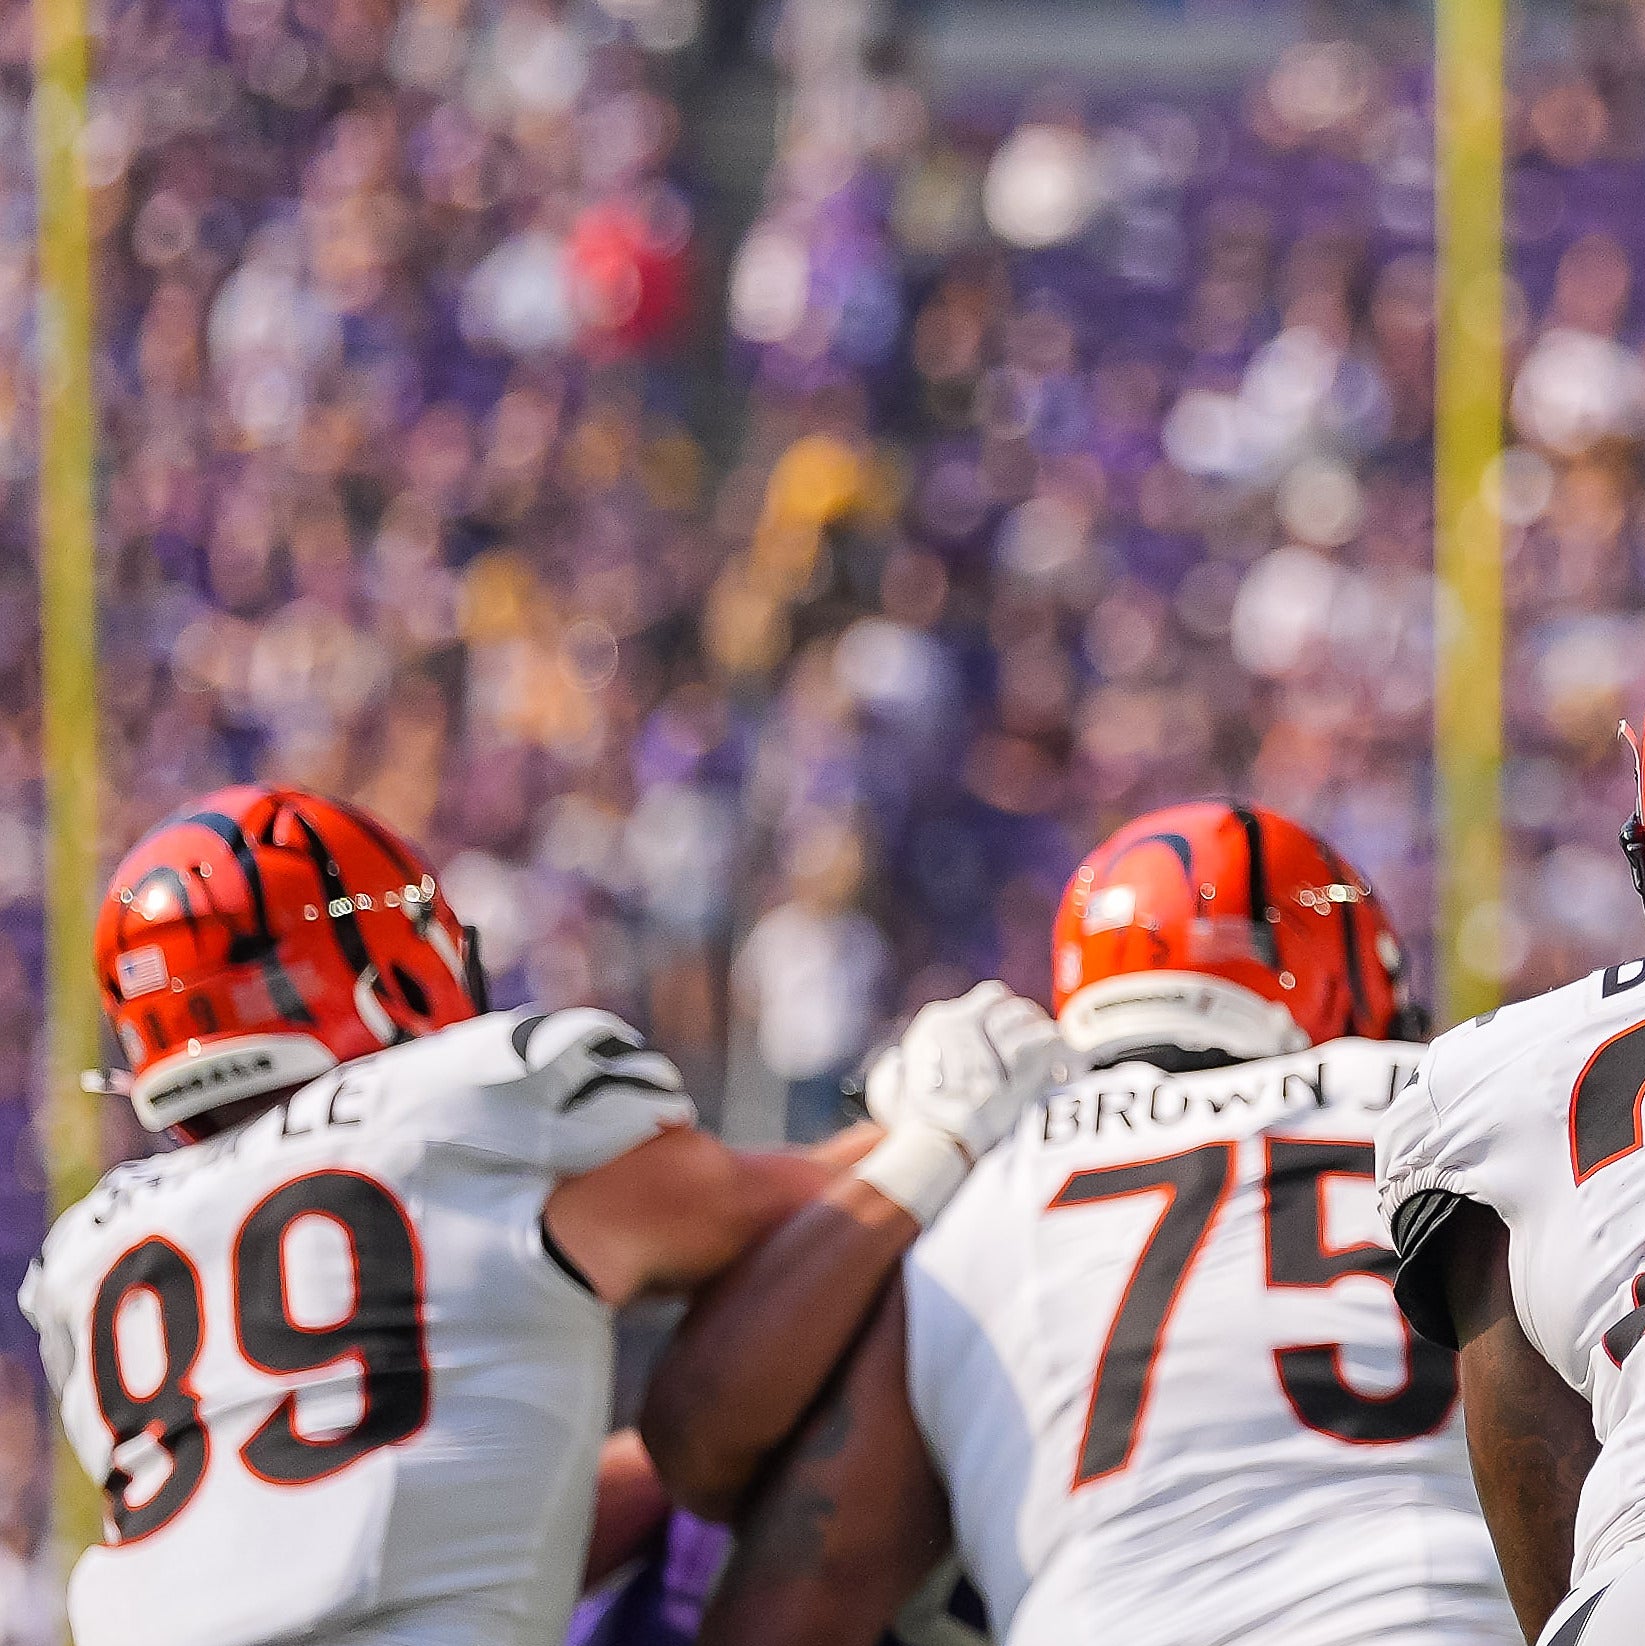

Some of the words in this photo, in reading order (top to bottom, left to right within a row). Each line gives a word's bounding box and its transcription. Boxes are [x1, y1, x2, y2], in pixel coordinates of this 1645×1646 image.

[1043, 1062, 1330, 1144] BROWN
[91, 1168, 430, 1547] 89
[1046, 1136, 1460, 1494] 75
